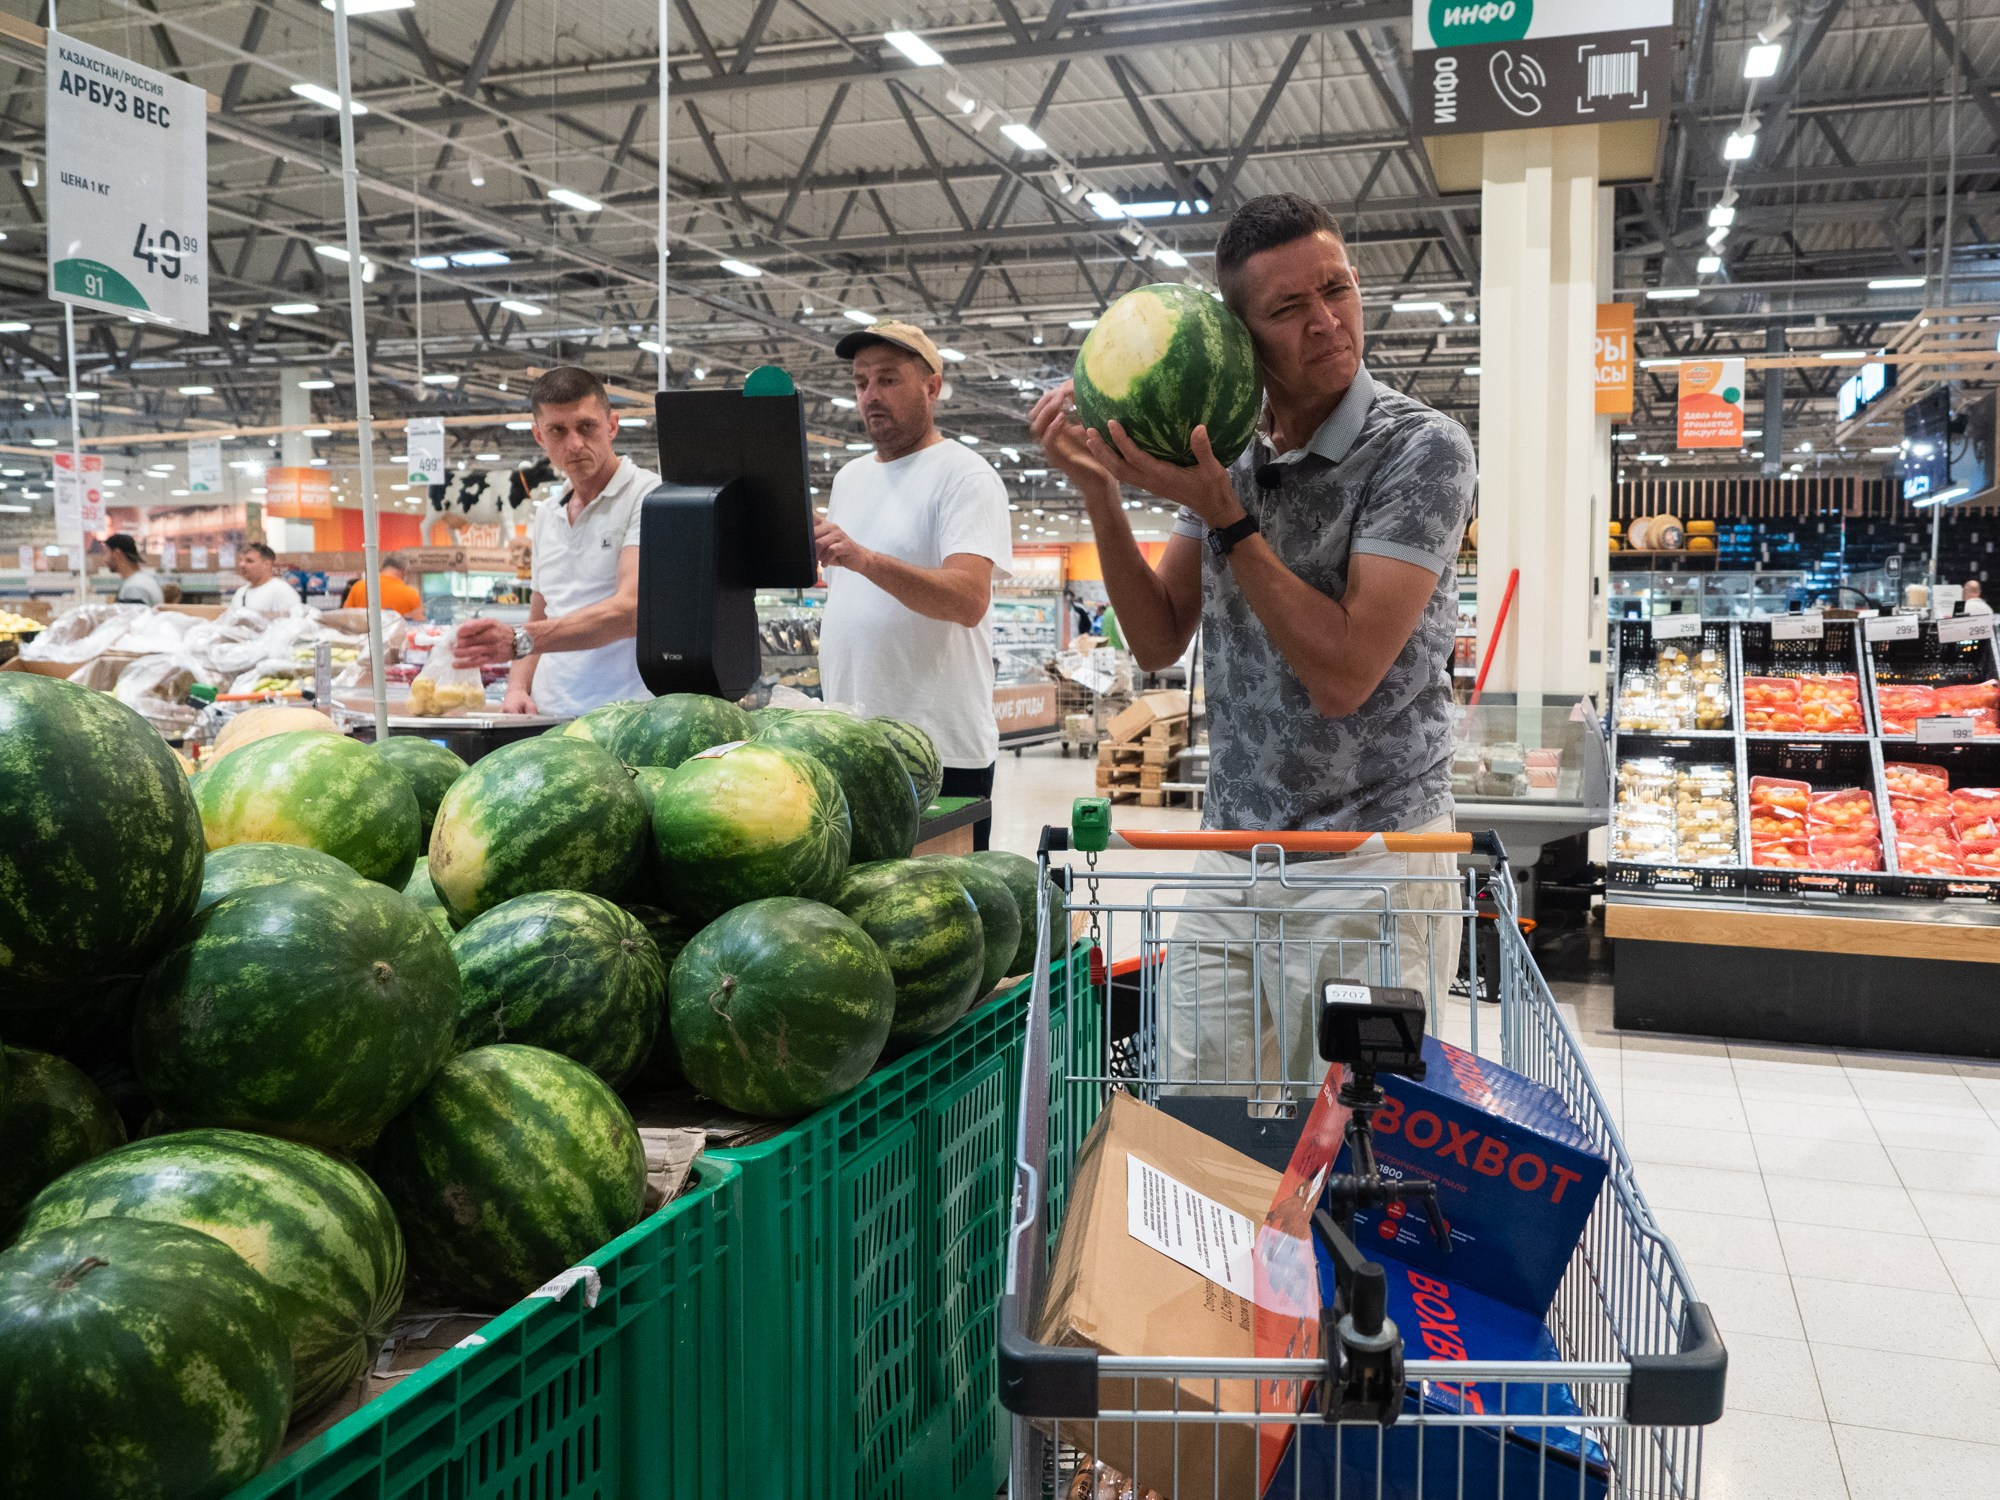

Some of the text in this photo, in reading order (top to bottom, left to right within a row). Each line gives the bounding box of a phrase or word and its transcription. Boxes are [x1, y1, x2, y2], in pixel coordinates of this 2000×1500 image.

[1443, 1, 1516, 27] ИНФО
[58, 47, 164, 96] КАЗАХСТАН/РОССИЯ
[1433, 57, 1459, 124] ИНФО
[59, 69, 170, 128] АРБУЗ ВЕС
[60, 171, 111, 196] ЦЕНА 1 КГ
[133, 222, 198, 280] 49 99
[84, 273, 104, 298] 91
[1332, 990, 1365, 998] 5707
[1371, 1095, 1582, 1204] BOXBOT
[1373, 1150, 1468, 1193] ектрическая пила
[1376, 1164, 1403, 1180] -1800
